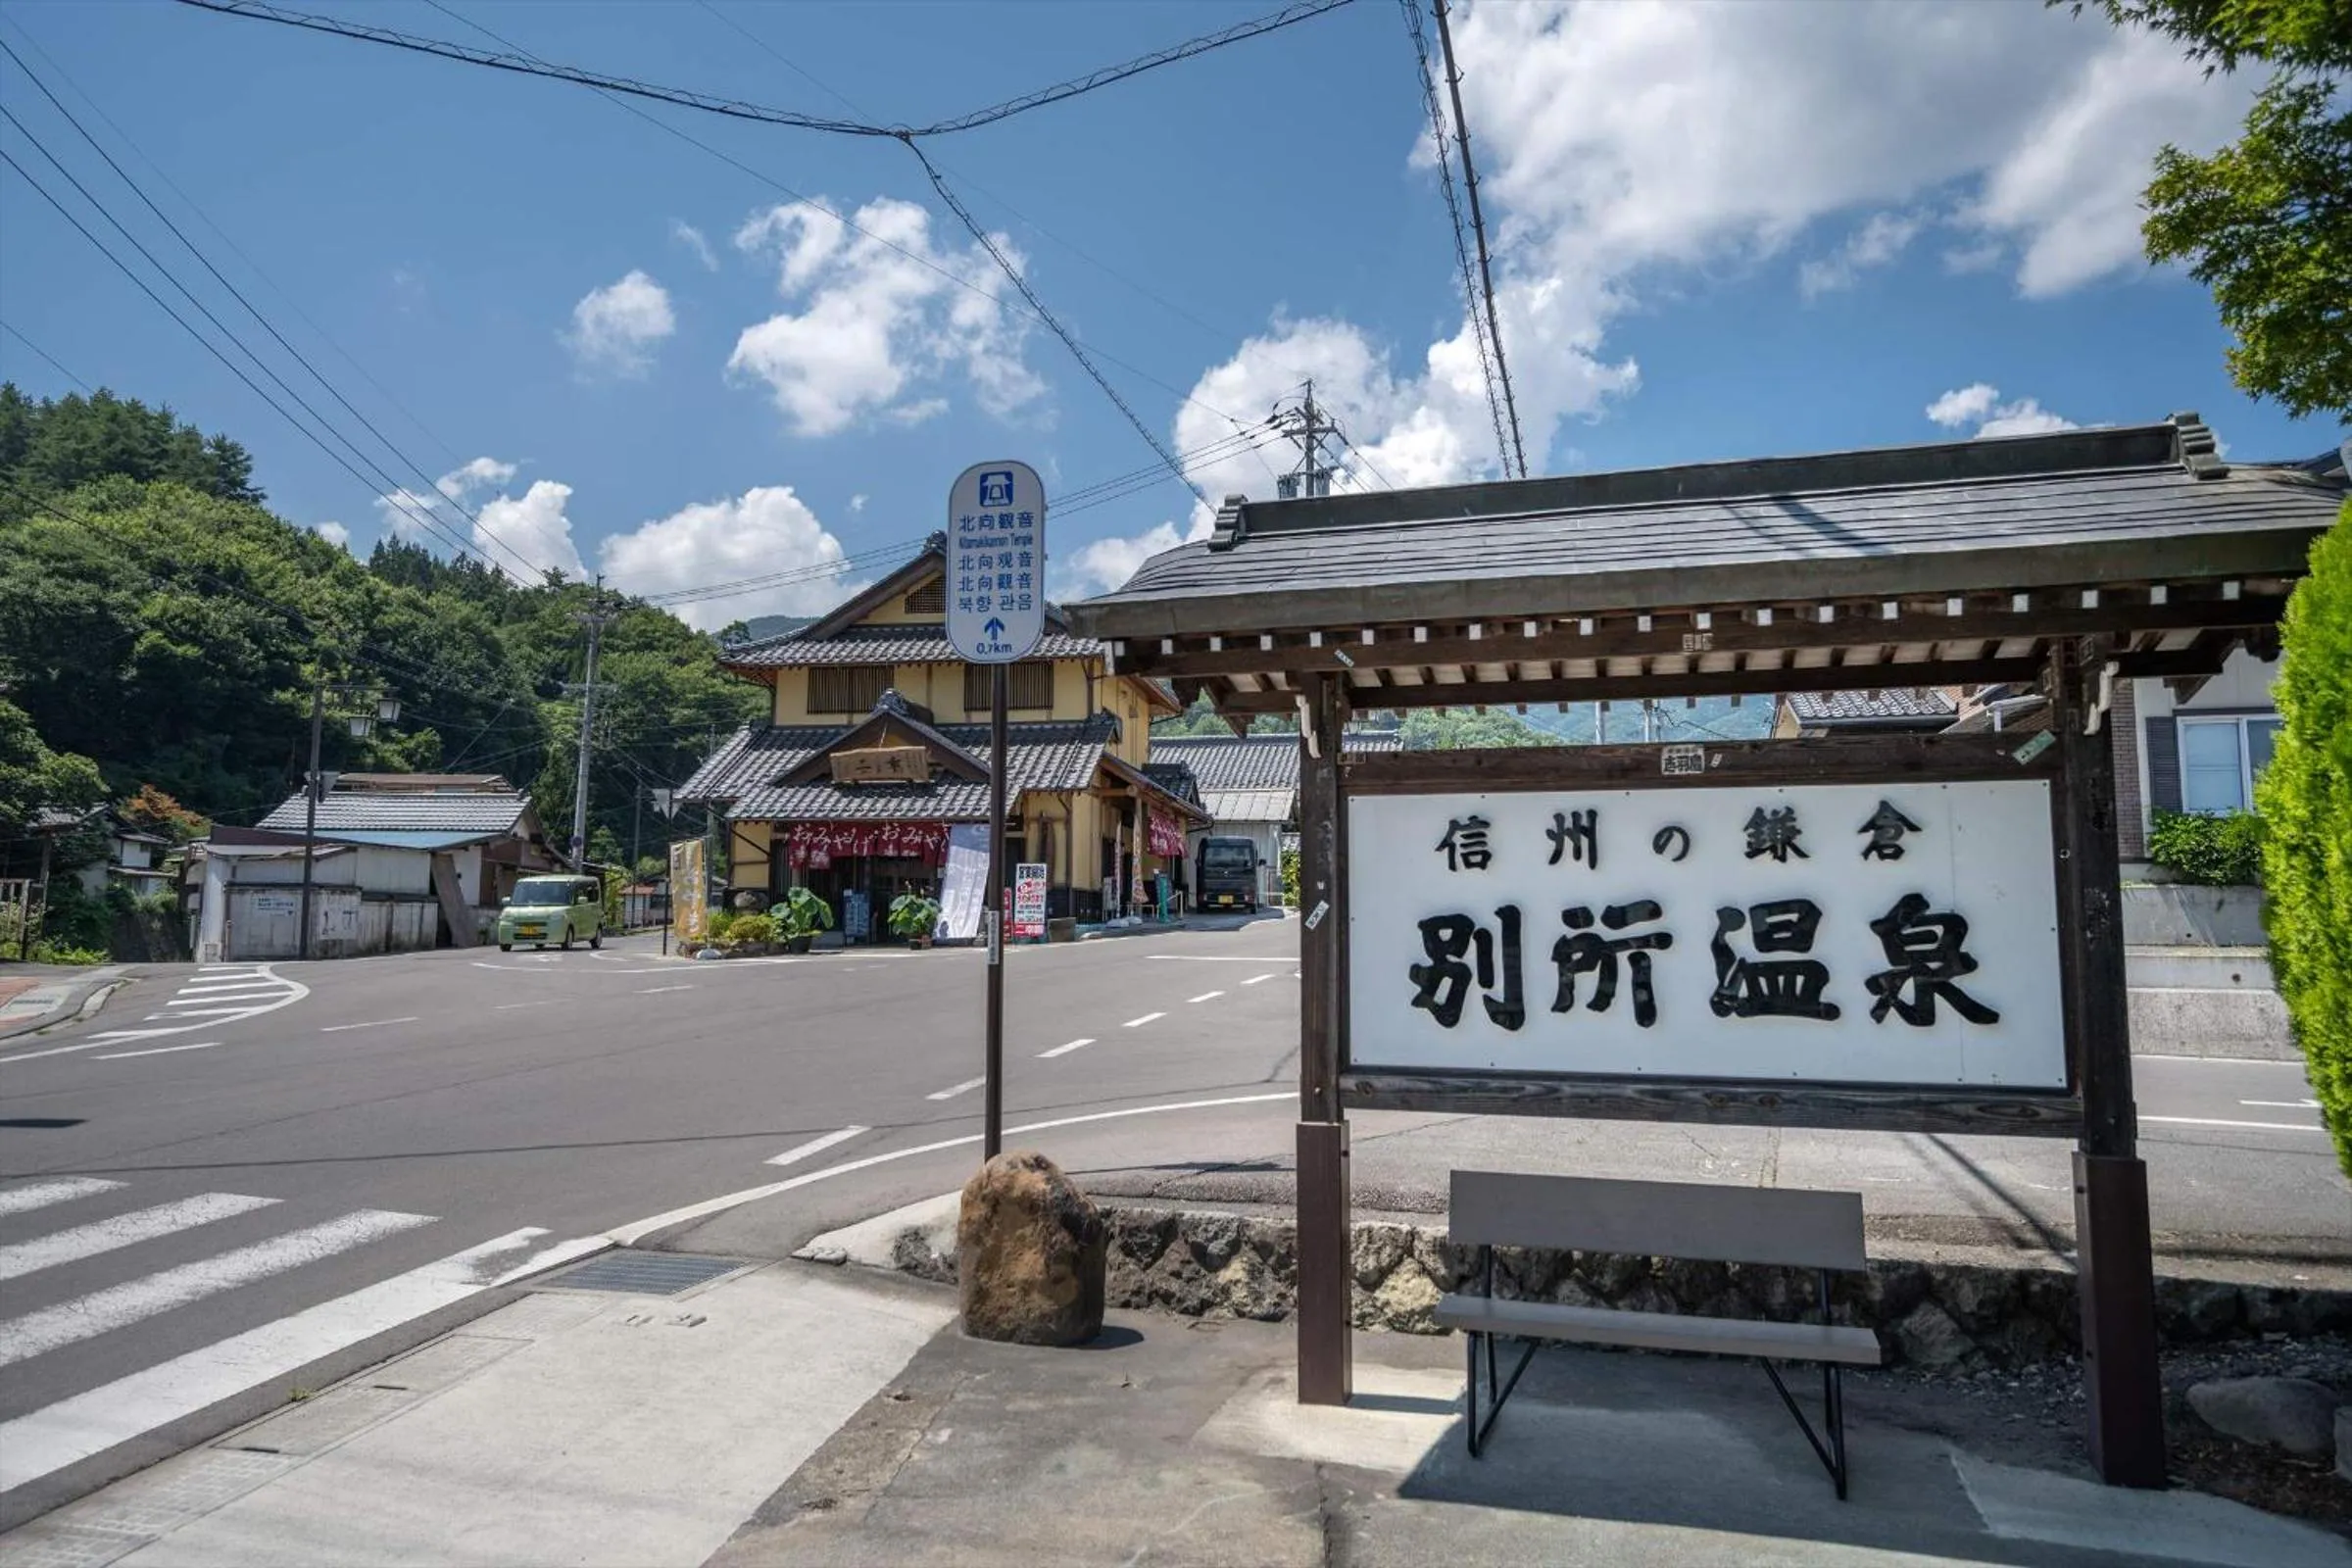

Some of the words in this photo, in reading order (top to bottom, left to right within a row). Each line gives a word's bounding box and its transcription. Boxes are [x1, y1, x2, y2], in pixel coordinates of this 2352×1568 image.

[957, 551, 1034, 570] 北向观音
[792, 823, 878, 857] おみやげ
[1436, 801, 1922, 871] 信州の鎌倉
[1409, 893, 2000, 1031] 別所温泉
